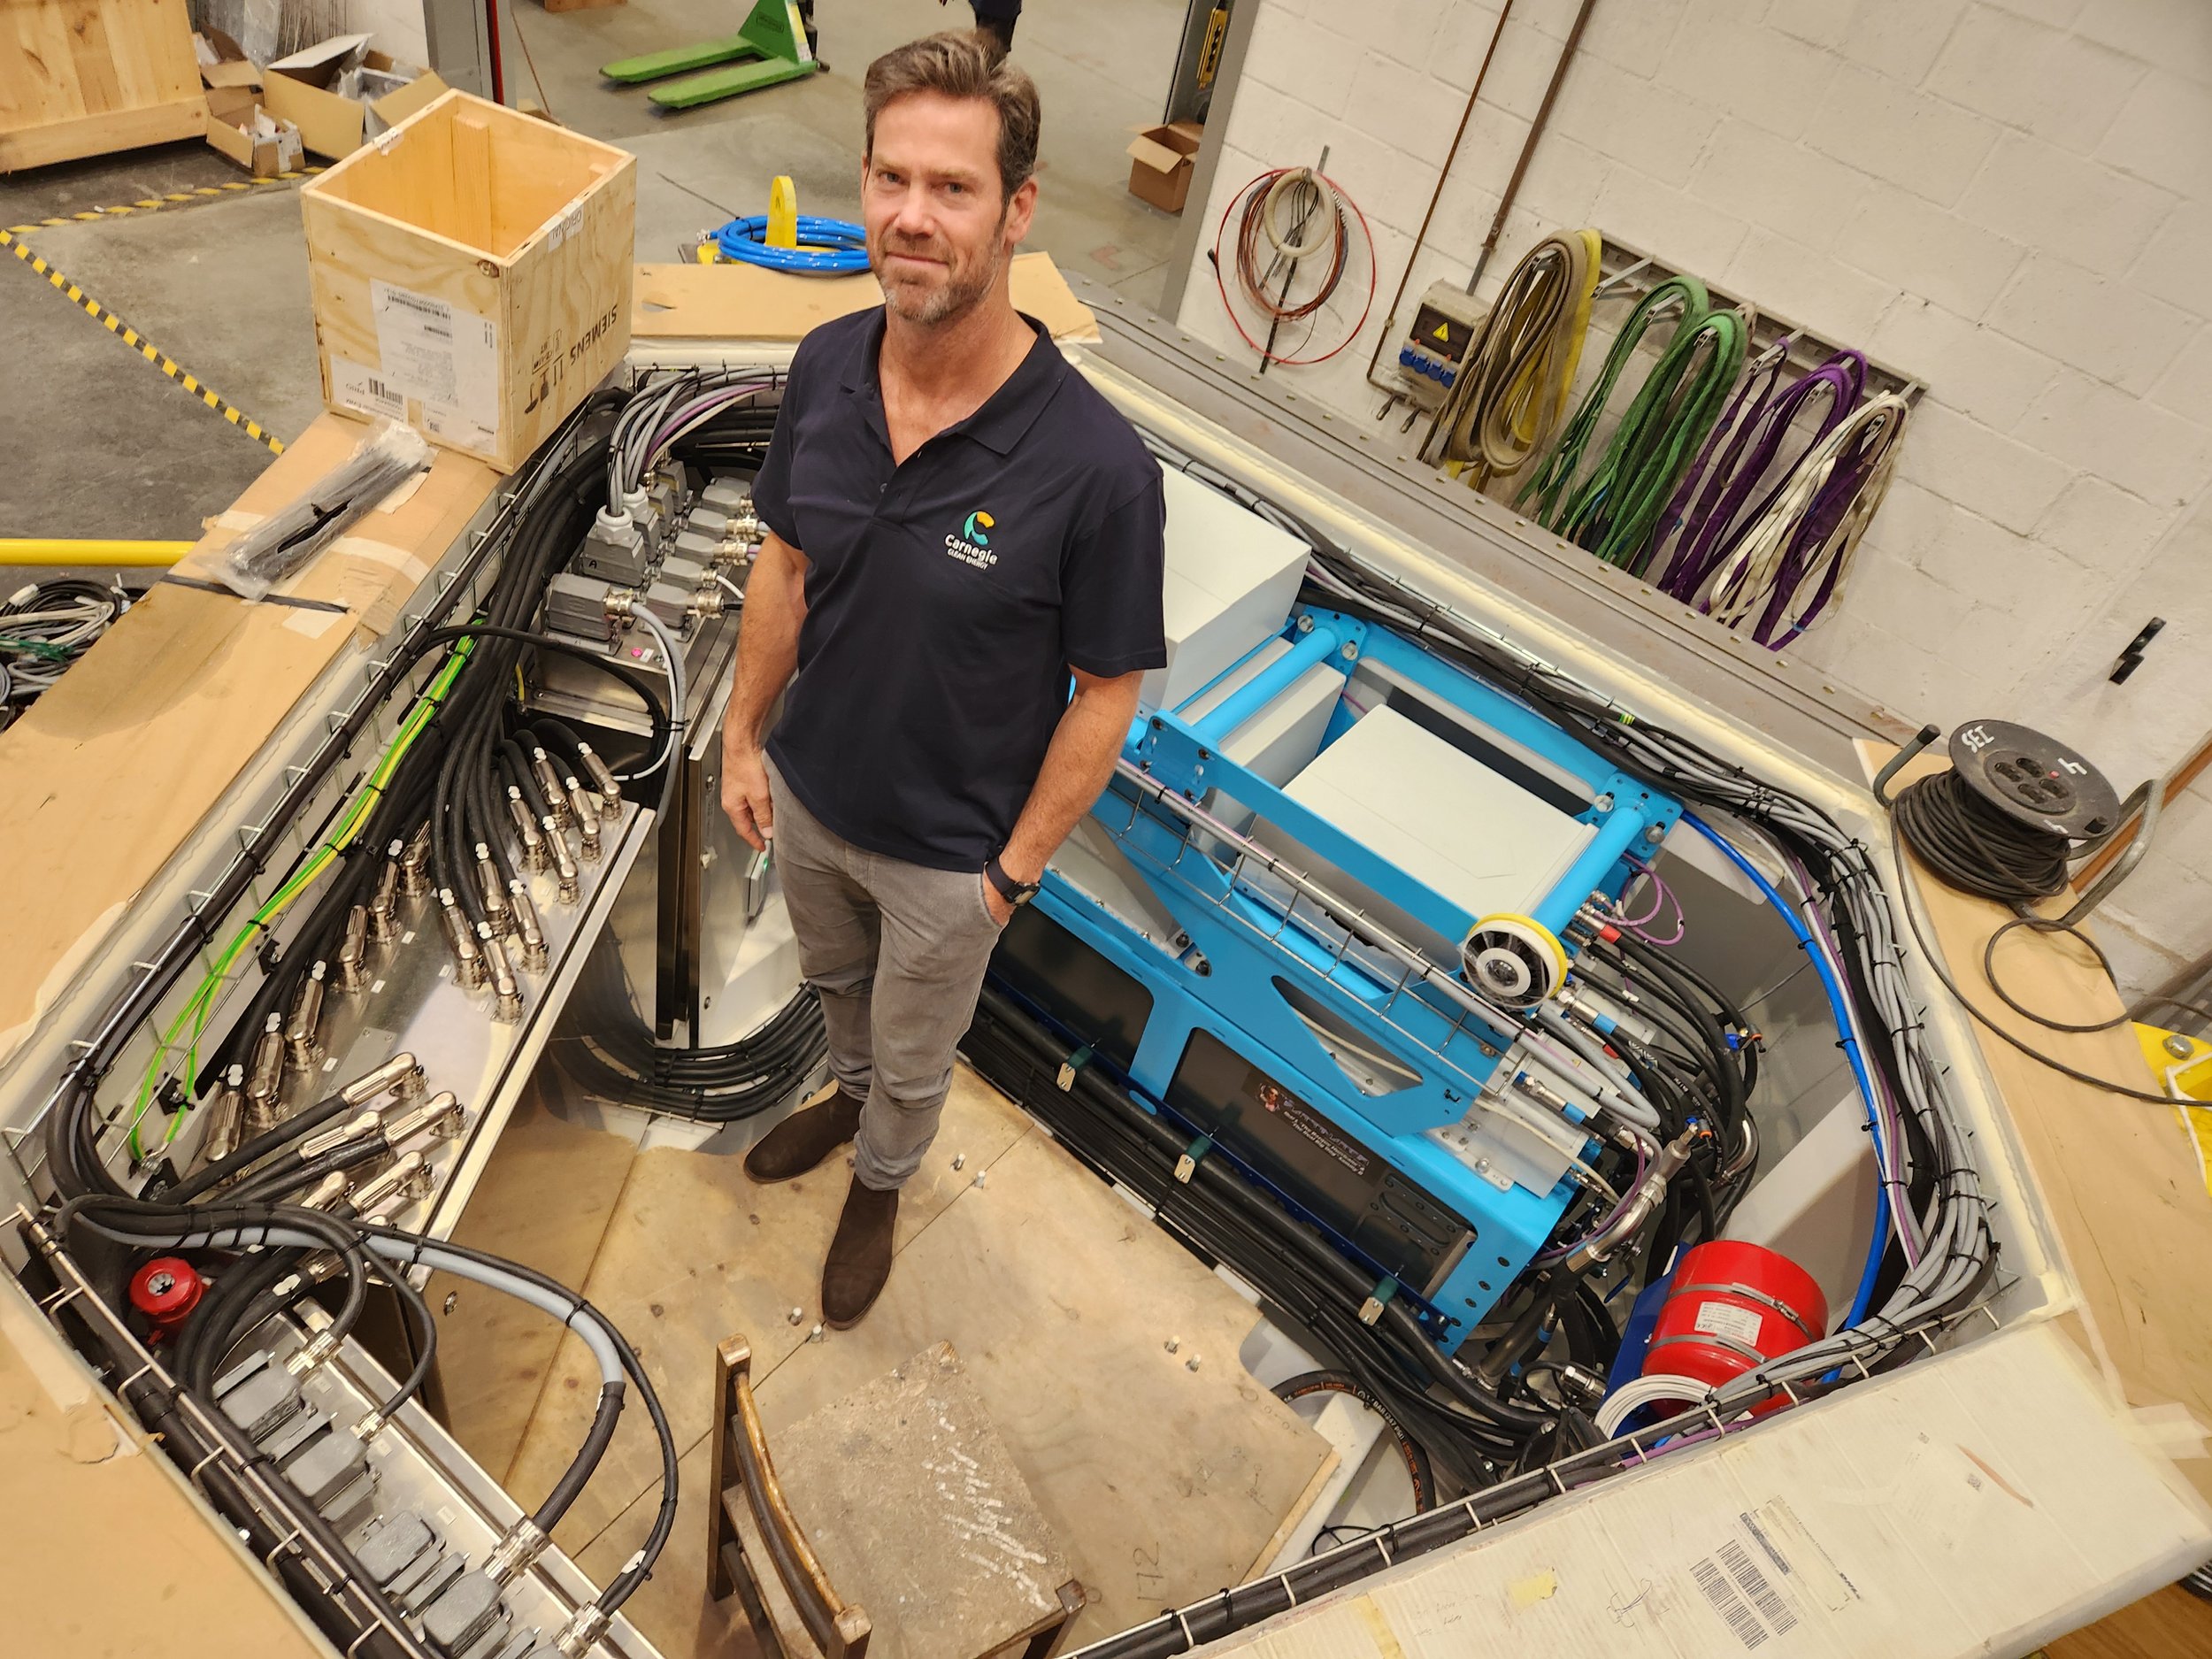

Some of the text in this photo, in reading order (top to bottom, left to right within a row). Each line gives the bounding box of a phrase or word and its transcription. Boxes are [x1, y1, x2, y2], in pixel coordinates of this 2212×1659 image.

[569, 303, 618, 366] SIEMENS
[944, 534, 998, 565] Carnegie
[947, 548, 989, 571] CLEAN ENERGY
[588, 559, 597, 570] A
[1961, 725, 1995, 754] SEI
[1373, 1401, 1386, 1415] BAR
[1133, 1541, 1164, 1601] 172
